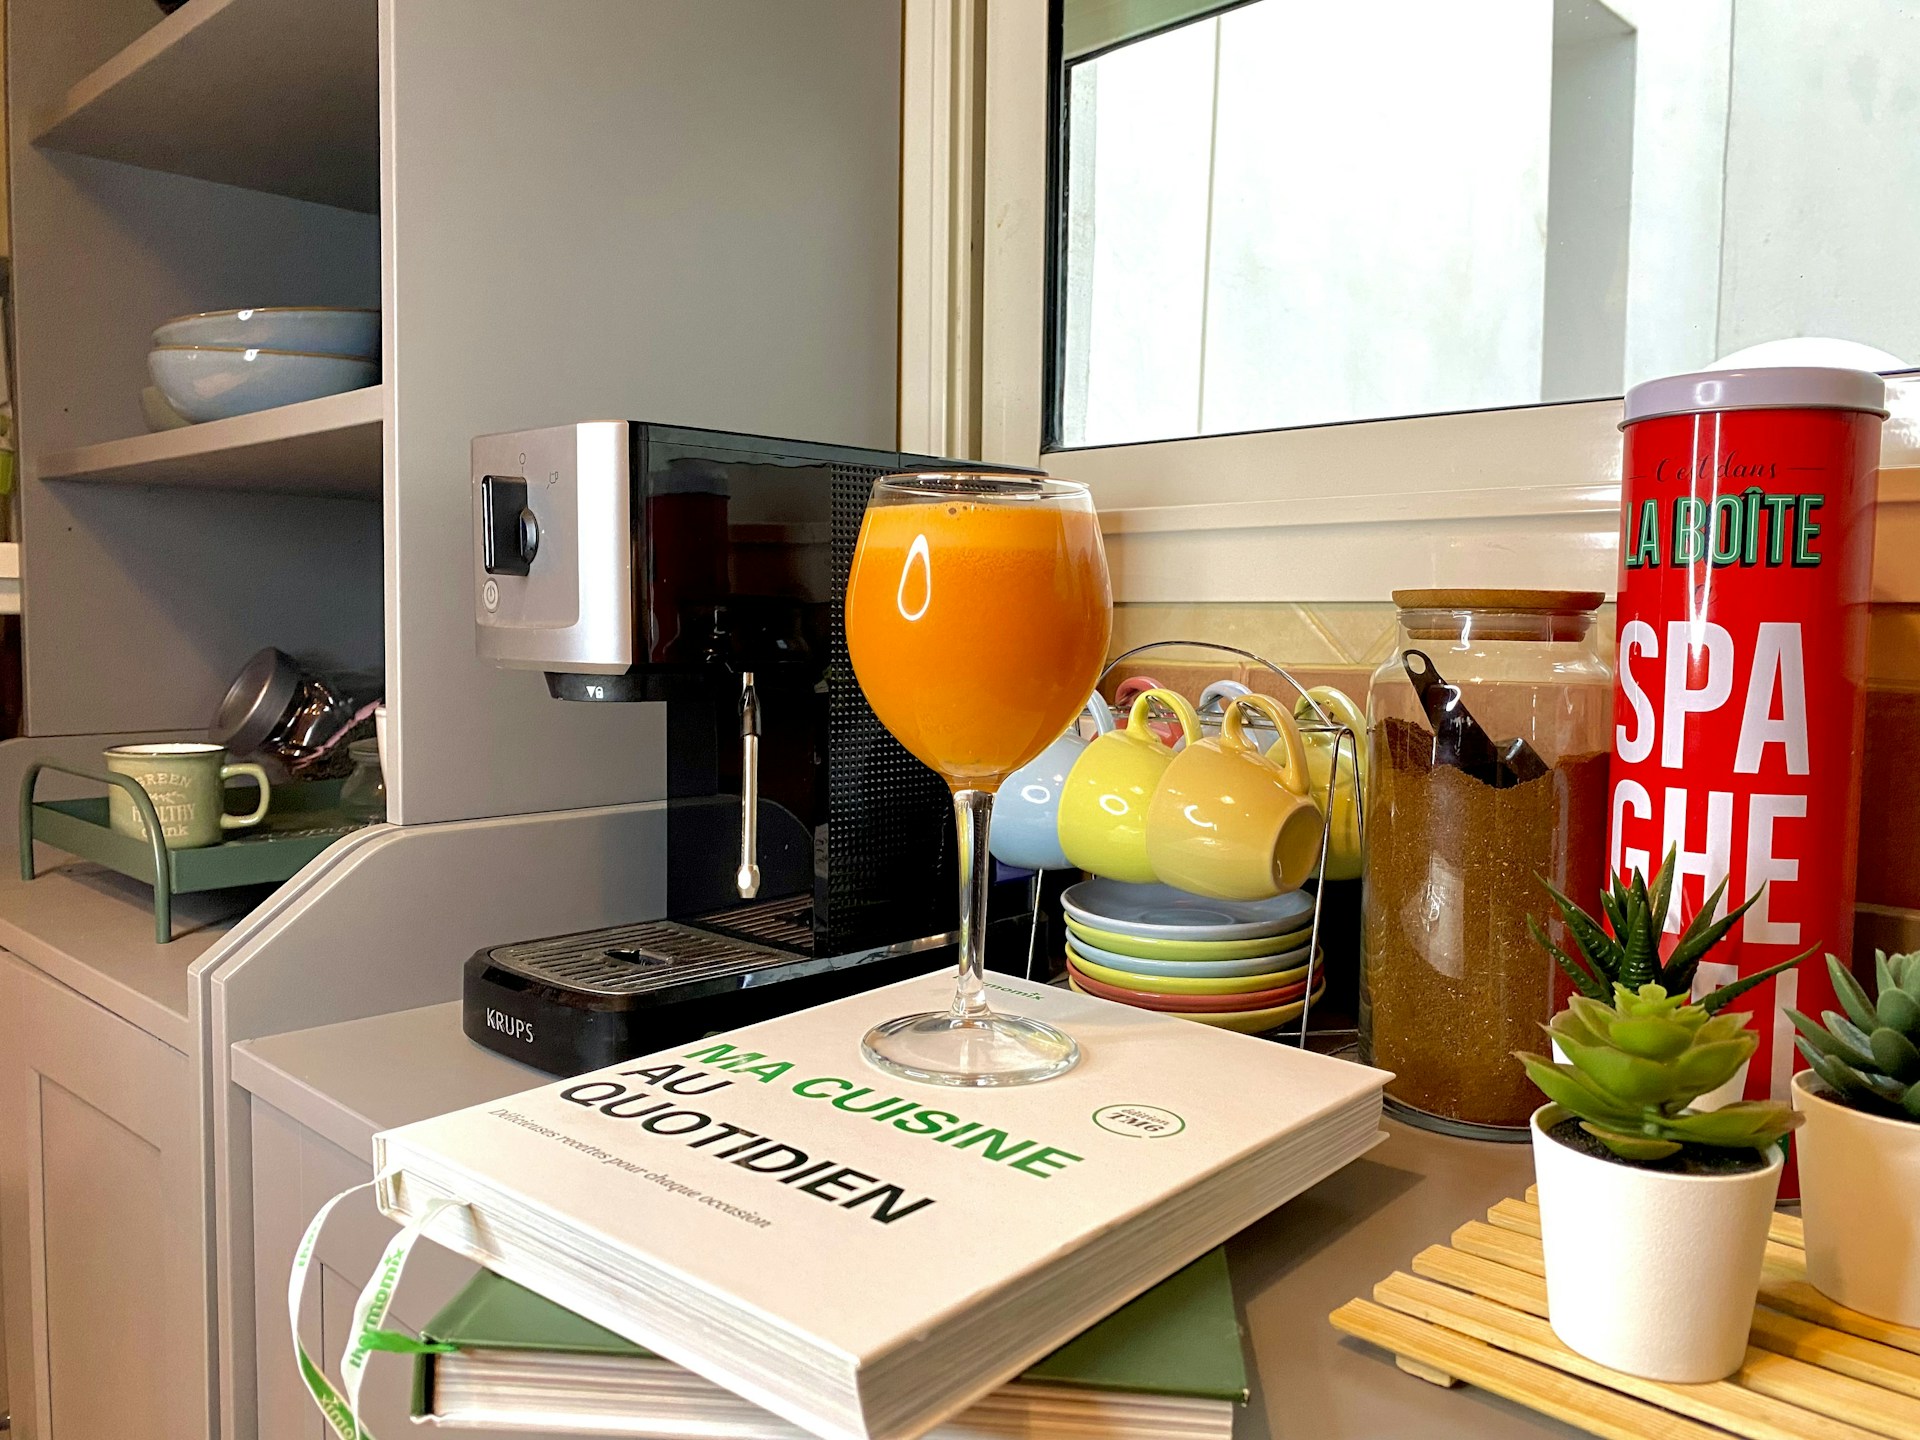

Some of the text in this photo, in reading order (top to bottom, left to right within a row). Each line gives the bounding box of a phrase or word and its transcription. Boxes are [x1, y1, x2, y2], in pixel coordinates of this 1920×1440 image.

[1716, 450, 1776, 480] dans
[1626, 486, 1825, 569] LA BOÎTE
[1616, 620, 1809, 775] SPA
[134, 772, 192, 788] GREEN
[131, 803, 196, 823] HLTHY
[1609, 779, 1807, 945] GHE
[486, 1007, 534, 1043] KRUPS
[617, 1064, 735, 1096] AU
[682, 1043, 1085, 1179] MA CUISINE
[1106, 1112, 1165, 1132] TM6
[487, 1108, 772, 1229] Délicieuses recettes pour chaque occasion
[559, 1082, 937, 1225] QUOTIDIEN
